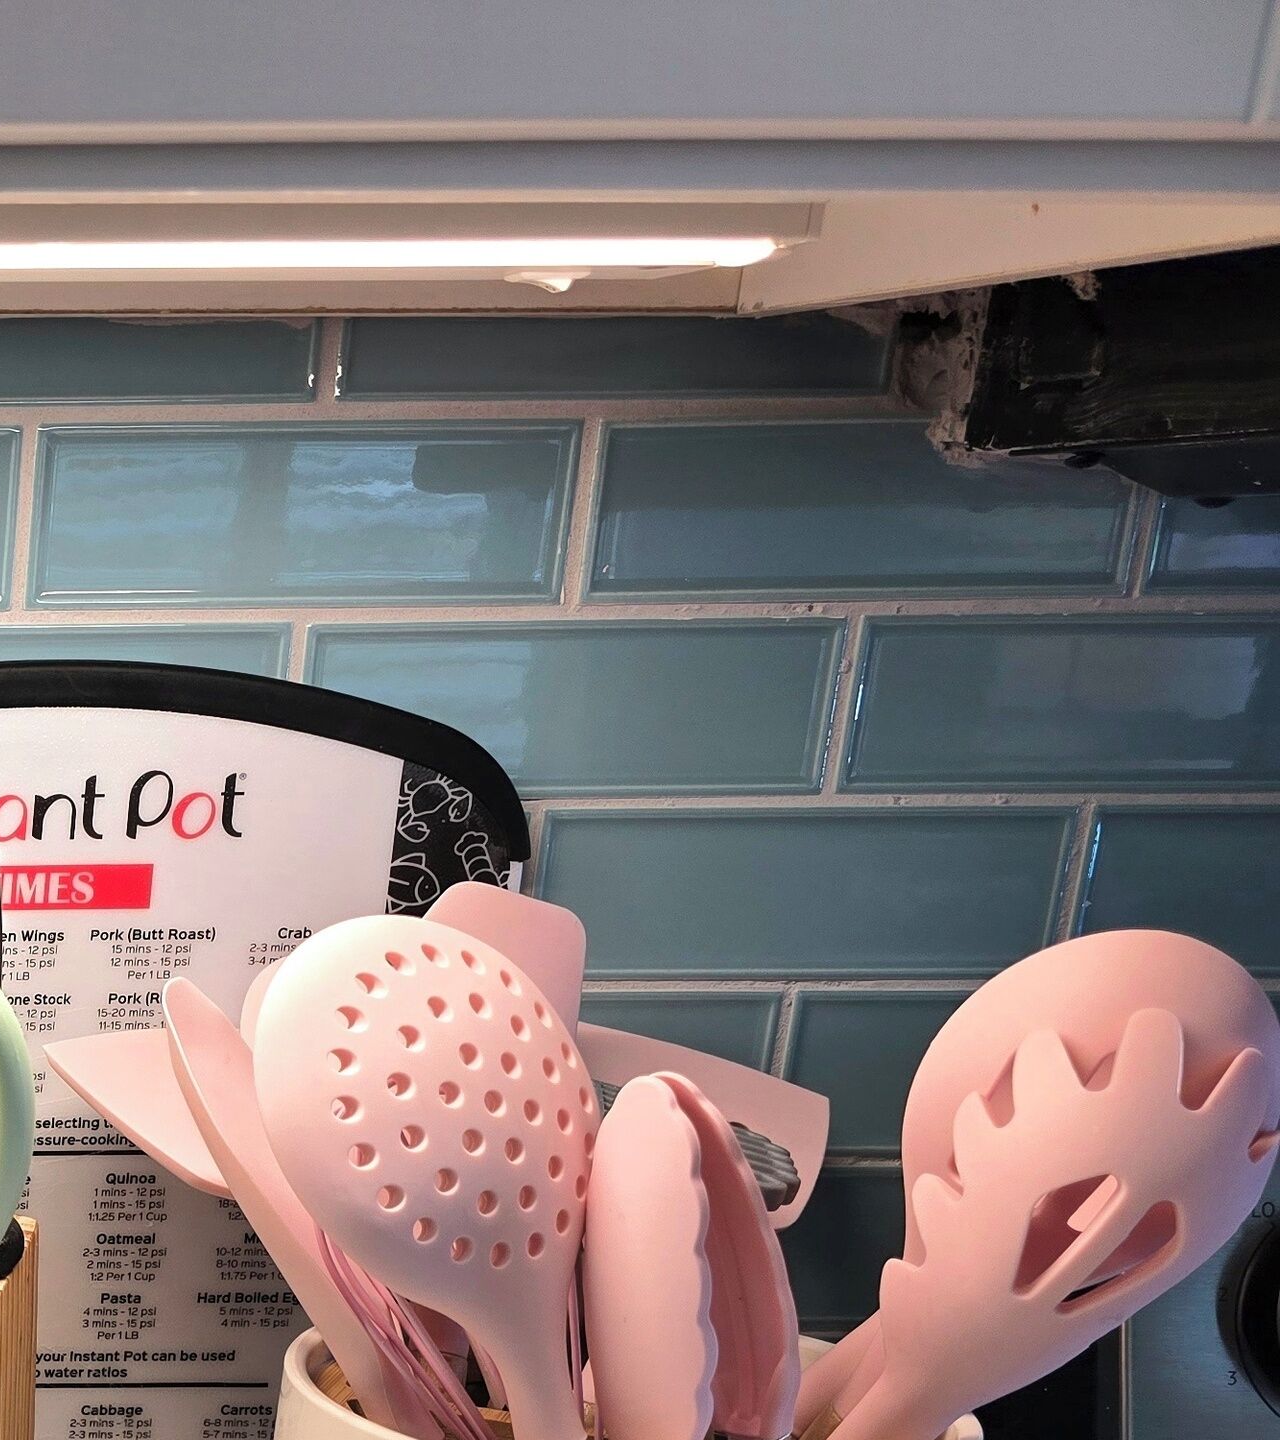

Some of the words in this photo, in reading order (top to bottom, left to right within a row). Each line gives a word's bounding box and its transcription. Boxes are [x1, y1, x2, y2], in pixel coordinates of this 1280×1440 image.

[1, 871, 96, 905] IMES
[21, 929, 64, 944] Wings
[90, 929, 124, 941] Pork
[128, 928, 164, 943] (Butt
[168, 927, 216, 942] Roast)
[278, 926, 312, 939] Crab
[112, 944, 123, 954] 15
[125, 944, 151, 954] mins
[162, 944, 173, 953] 12
[175, 943, 192, 955] psi
[249, 943, 268, 953] 2-3
[111, 957, 121, 967] 12
[124, 957, 150, 967] mins
[160, 957, 171, 966] 15
[174, 957, 191, 968] psi
[128, 970, 147, 980] Per
[156, 970, 171, 979] LB
[34, 993, 71, 1005] Stock
[108, 992, 142, 1004] Pork
[97, 1008, 126, 1018] 15-20
[129, 1008, 155, 1017] mins
[99, 1021, 121, 1030] 11-15
[124, 1020, 150, 1030] mins
[35, 1117, 100, 1131] selecting
[106, 1172, 156, 1185] Quinoa
[101, 1187, 127, 1197] mins
[136, 1187, 147, 1197] 12
[149, 1187, 165, 1198] psi
[118, 1212, 137, 1221] Per
[146, 1212, 167, 1223] Cup
[96, 1233, 156, 1245] Oatmeal
[82, 1248, 100, 1257] 2-3
[103, 1247, 128, 1257] mins
[138, 1247, 149, 1256] 12
[151, 1247, 167, 1258] psi
[216, 1247, 242, 1256] 10-12
[96, 1259, 122, 1269] mins
[131, 1259, 142, 1269] 15
[145, 1259, 161, 1270] psi
[106, 1272, 125, 1281] Per
[134, 1272, 155, 1283] Cup
[101, 1293, 141, 1304] Pasta
[197, 1292, 231, 1304] Hard
[234, 1292, 279, 1303] Boiled
[93, 1307, 118, 1316] mins
[128, 1307, 138, 1316] 12
[140, 1307, 157, 1318] psi
[229, 1306, 254, 1316] mins
[264, 1306, 275, 1315] 12
[277, 1306, 293, 1317] psi
[92, 1318, 117, 1328] mins
[127, 1319, 137, 1328] 15
[139, 1319, 156, 1329] psi
[230, 1318, 250, 1327] min
[260, 1318, 271, 1327] 15
[273, 1318, 289, 1328] psi
[97, 1331, 116, 1340] Per
[125, 1331, 139, 1340] LB
[36, 1353, 67, 1365] your
[69, 1351, 120, 1362] Instant
[123, 1351, 148, 1362] Pot
[151, 1352, 176, 1362] can
[180, 1350, 197, 1361] be
[201, 1350, 235, 1361] used
[44, 1367, 84, 1378] water
[87, 1366, 128, 1378] ratios
[1227, 1370, 1238, 1387] 3
[81, 1404, 143, 1418] Cabbage
[220, 1404, 272, 1416] Carrots
[70, 1418, 87, 1428] 2-3
[89, 1418, 114, 1428] mins
[124, 1418, 134, 1427] 12
[136, 1418, 152, 1429] psi
[203, 1418, 222, 1427] 6-8
[224, 1418, 249, 1427] mins
[259, 1418, 269, 1427] 12
[68, 1430, 86, 1439] 2-3
[88, 1430, 113, 1439] mins
[122, 1430, 133, 1439] 15
[136, 1430, 151, 1440] psi
